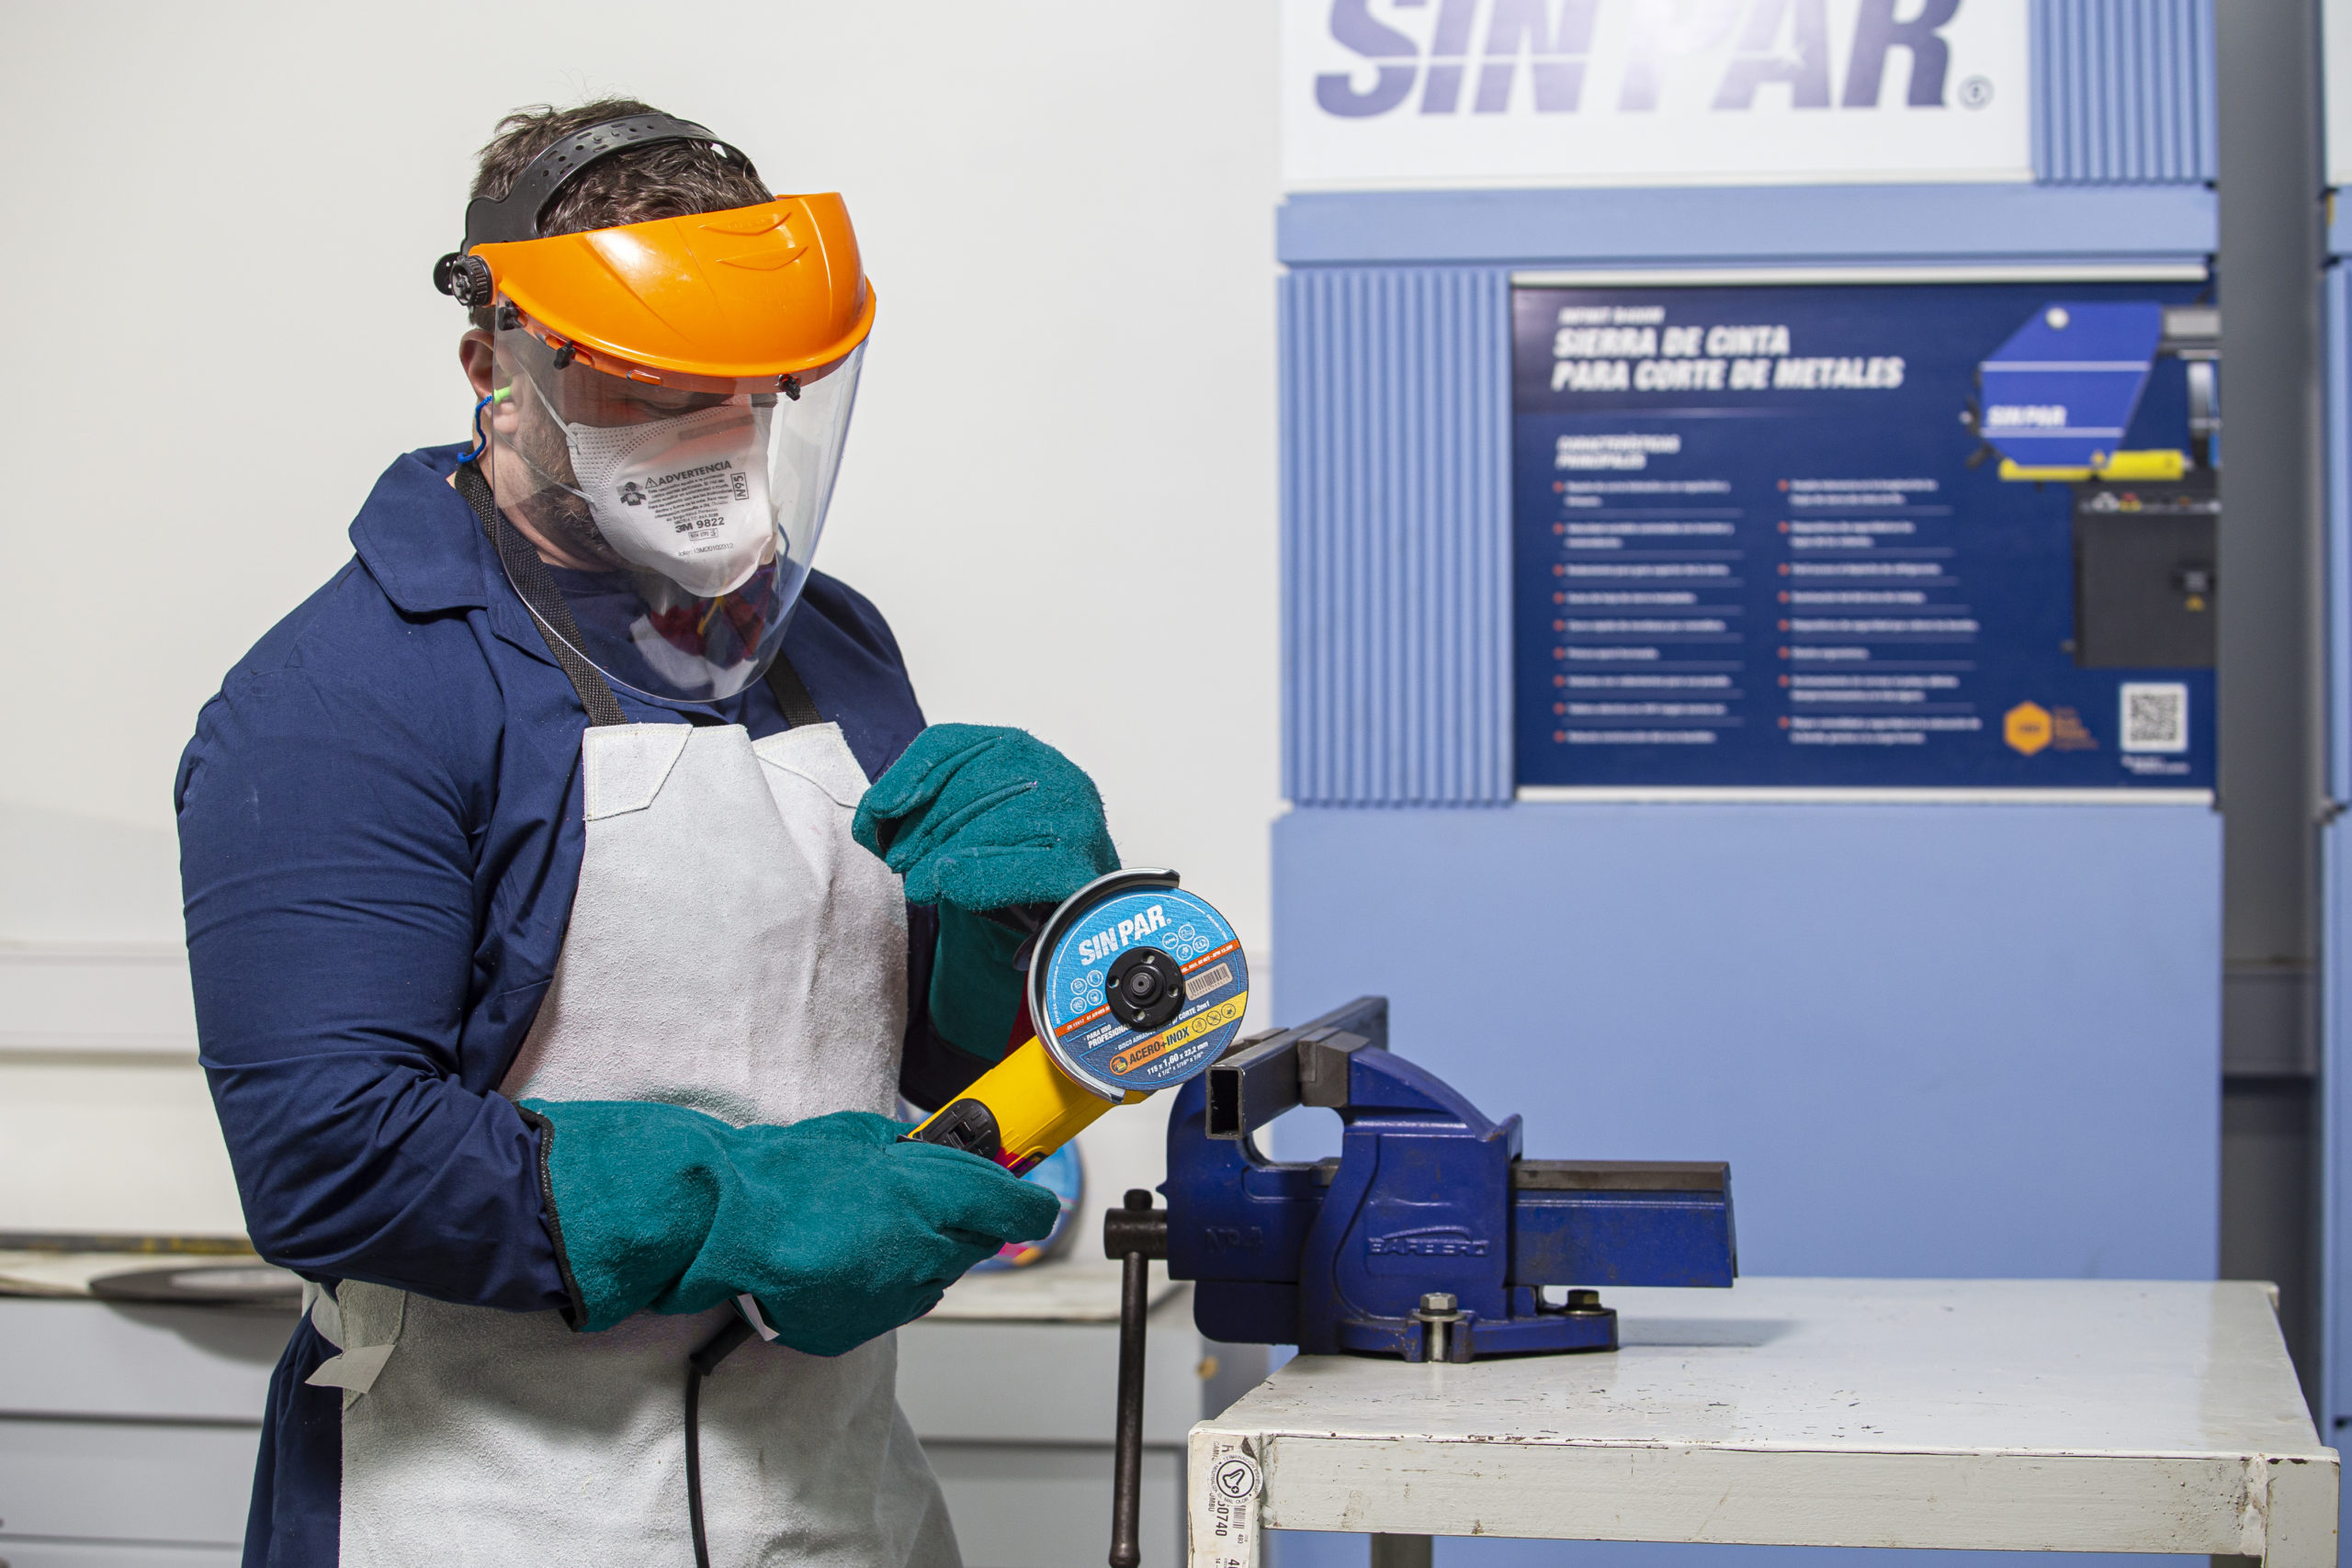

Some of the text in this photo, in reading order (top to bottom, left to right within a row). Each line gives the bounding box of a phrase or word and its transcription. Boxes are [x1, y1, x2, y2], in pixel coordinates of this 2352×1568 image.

[1315, 0, 1598, 118] SIN
[1554, 325, 1790, 358] SIERRA DE CINTA
[1551, 356, 1905, 391] PARA CORTE DE METALES
[658, 460, 732, 486] ADVERTENCIA
[733, 475, 747, 498] N95
[675, 523, 694, 534] 3M
[695, 516, 725, 529] 9822
[1079, 927, 1119, 966] SIN
[1117, 904, 1167, 947] PAR
[1086, 1023, 1112, 1041] PARA USO
[1088, 1022, 1133, 1049] PROFESIONAL
[1117, 1039, 1133, 1051] DISCO
[1178, 1007, 1197, 1021] CORTE
[1129, 1026, 1191, 1066] ACERO+INOX
[1147, 1065, 1159, 1075] 115
[1162, 1053, 1180, 1066] 1,60
[1196, 1041, 1209, 1050] mm
